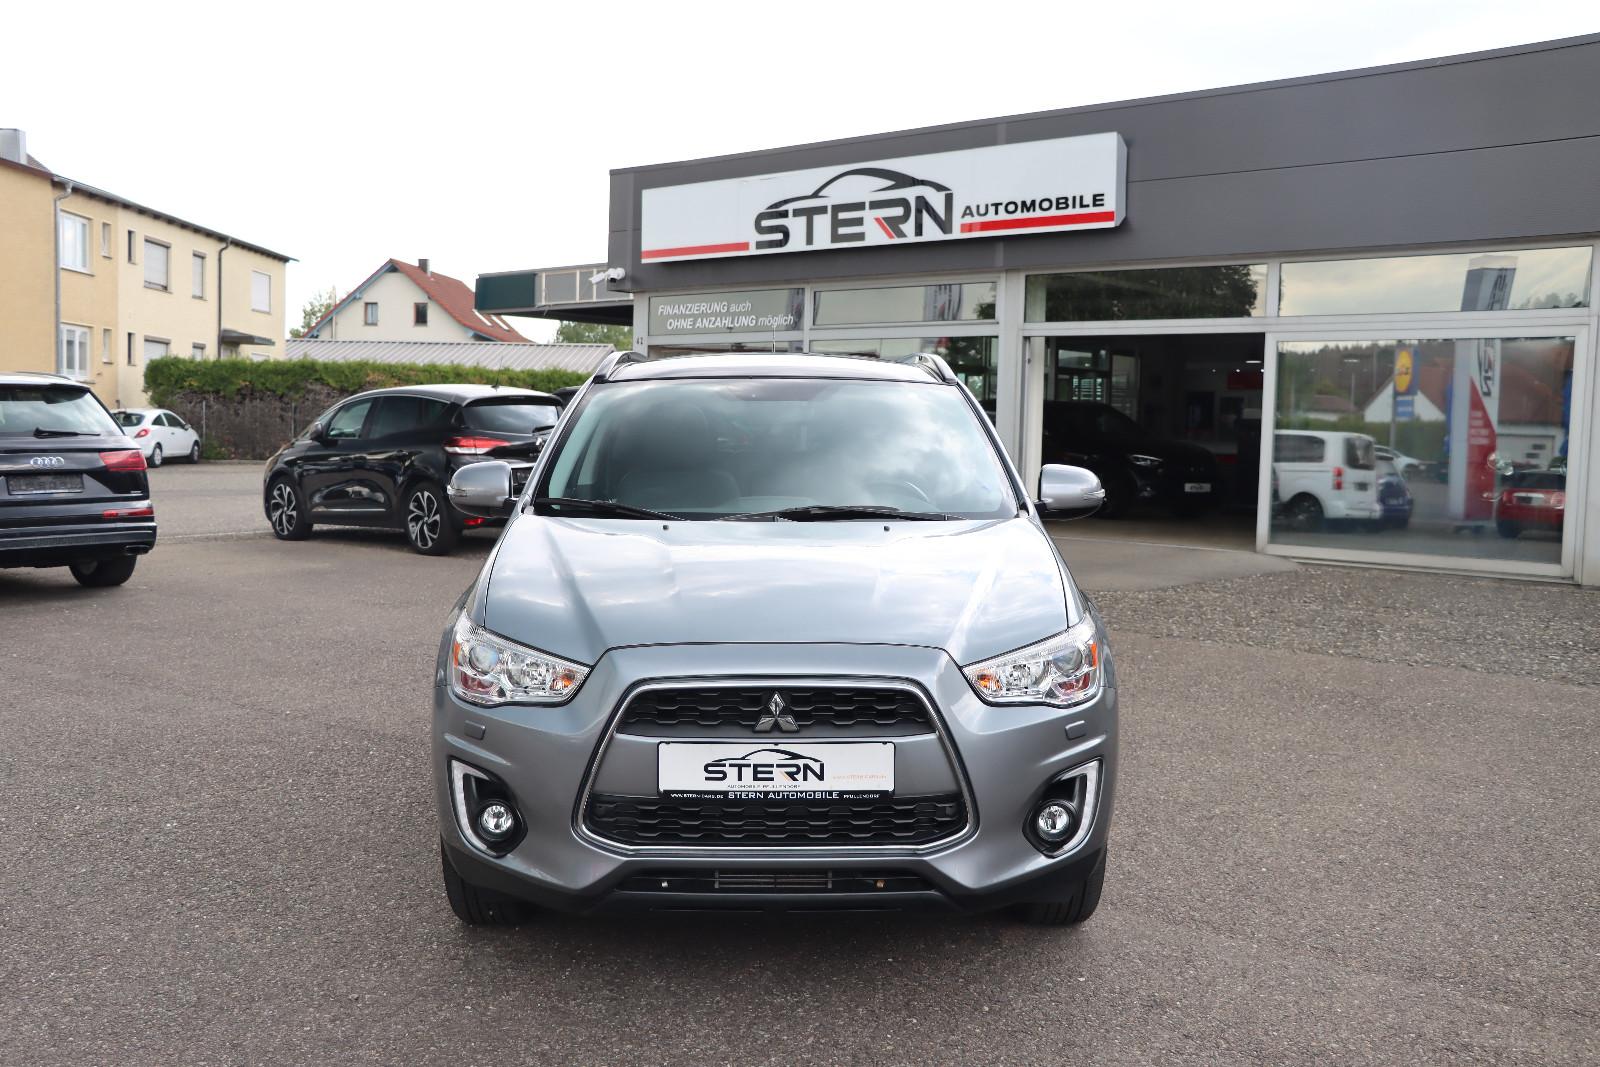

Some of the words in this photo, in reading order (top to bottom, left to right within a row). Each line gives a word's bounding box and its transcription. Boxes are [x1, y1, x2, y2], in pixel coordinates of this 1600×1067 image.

[754, 191, 953, 250] STERN
[961, 193, 1106, 219] AUTOMOBILE
[658, 302, 728, 316] FINANZIERUNG
[729, 301, 752, 312] auch
[667, 318, 693, 330] OHNE
[695, 315, 756, 329] ANZAHLUNG
[758, 314, 794, 328] möglich
[703, 762, 825, 782] STERN
[727, 791, 764, 799] STERN
[767, 791, 840, 799] AUTOMOBILE
